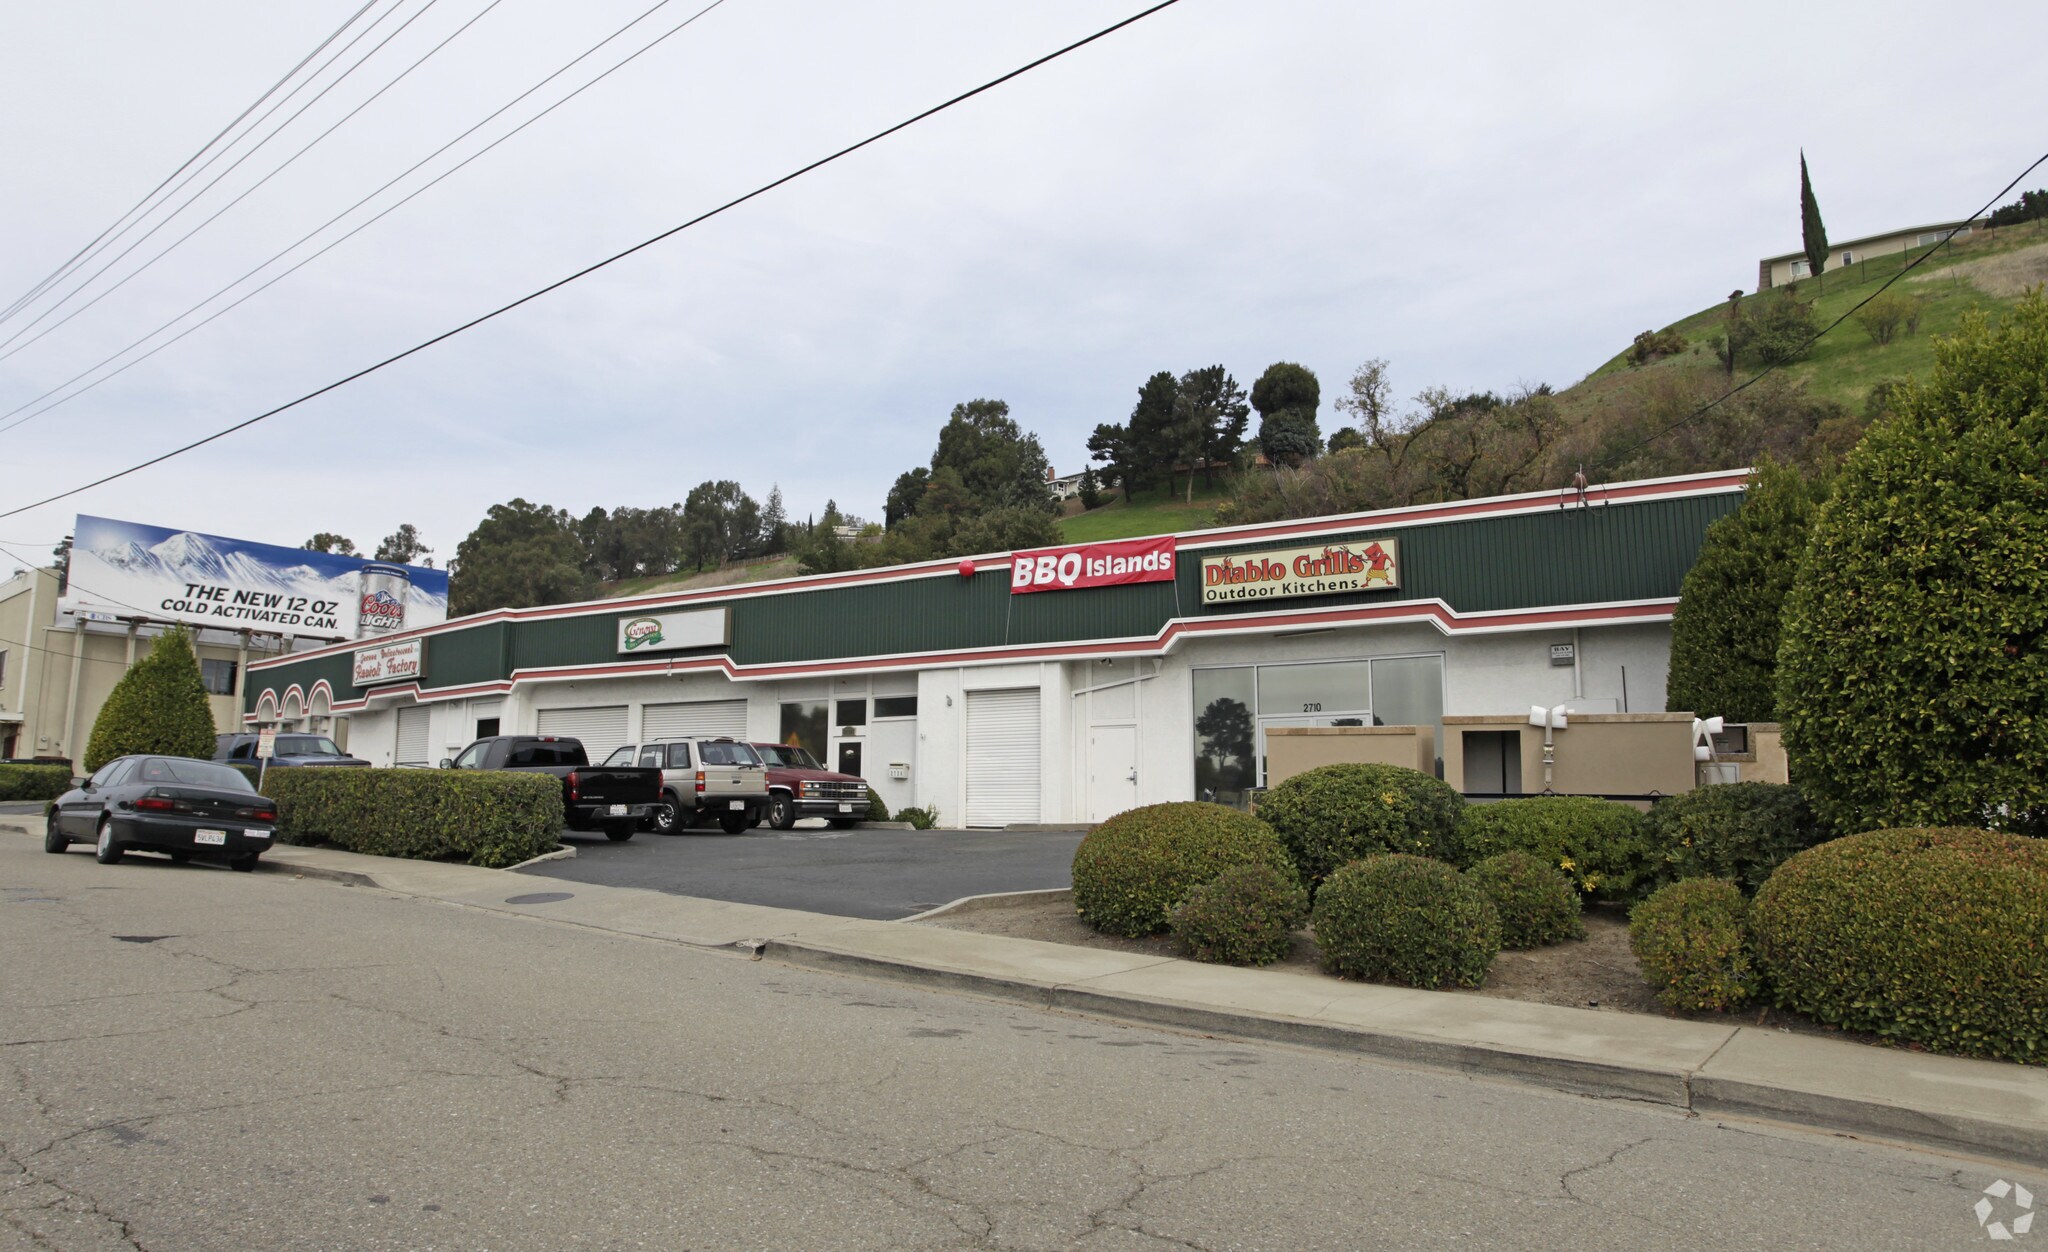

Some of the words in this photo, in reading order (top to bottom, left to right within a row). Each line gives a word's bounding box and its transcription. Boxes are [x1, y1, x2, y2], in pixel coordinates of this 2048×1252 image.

[1012, 552, 1083, 588] BBQ
[1086, 550, 1171, 577] Islands
[1205, 557, 1286, 587] Diablo
[1293, 549, 1364, 578] Grills
[185, 583, 229, 602] THE
[233, 590, 283, 609] NEW
[286, 597, 308, 612] 12
[311, 600, 339, 616] OZ
[1206, 586, 1276, 601] Outdoor
[1282, 579, 1358, 594] Kitchens
[160, 599, 208, 614] COLD
[211, 605, 301, 625] ACTIVATED
[304, 615, 338, 630] CAN.
[360, 594, 402, 616] Coors
[360, 614, 401, 629] LIGHT
[386, 657, 418, 674] Factory
[1303, 702, 1322, 713] 2710
